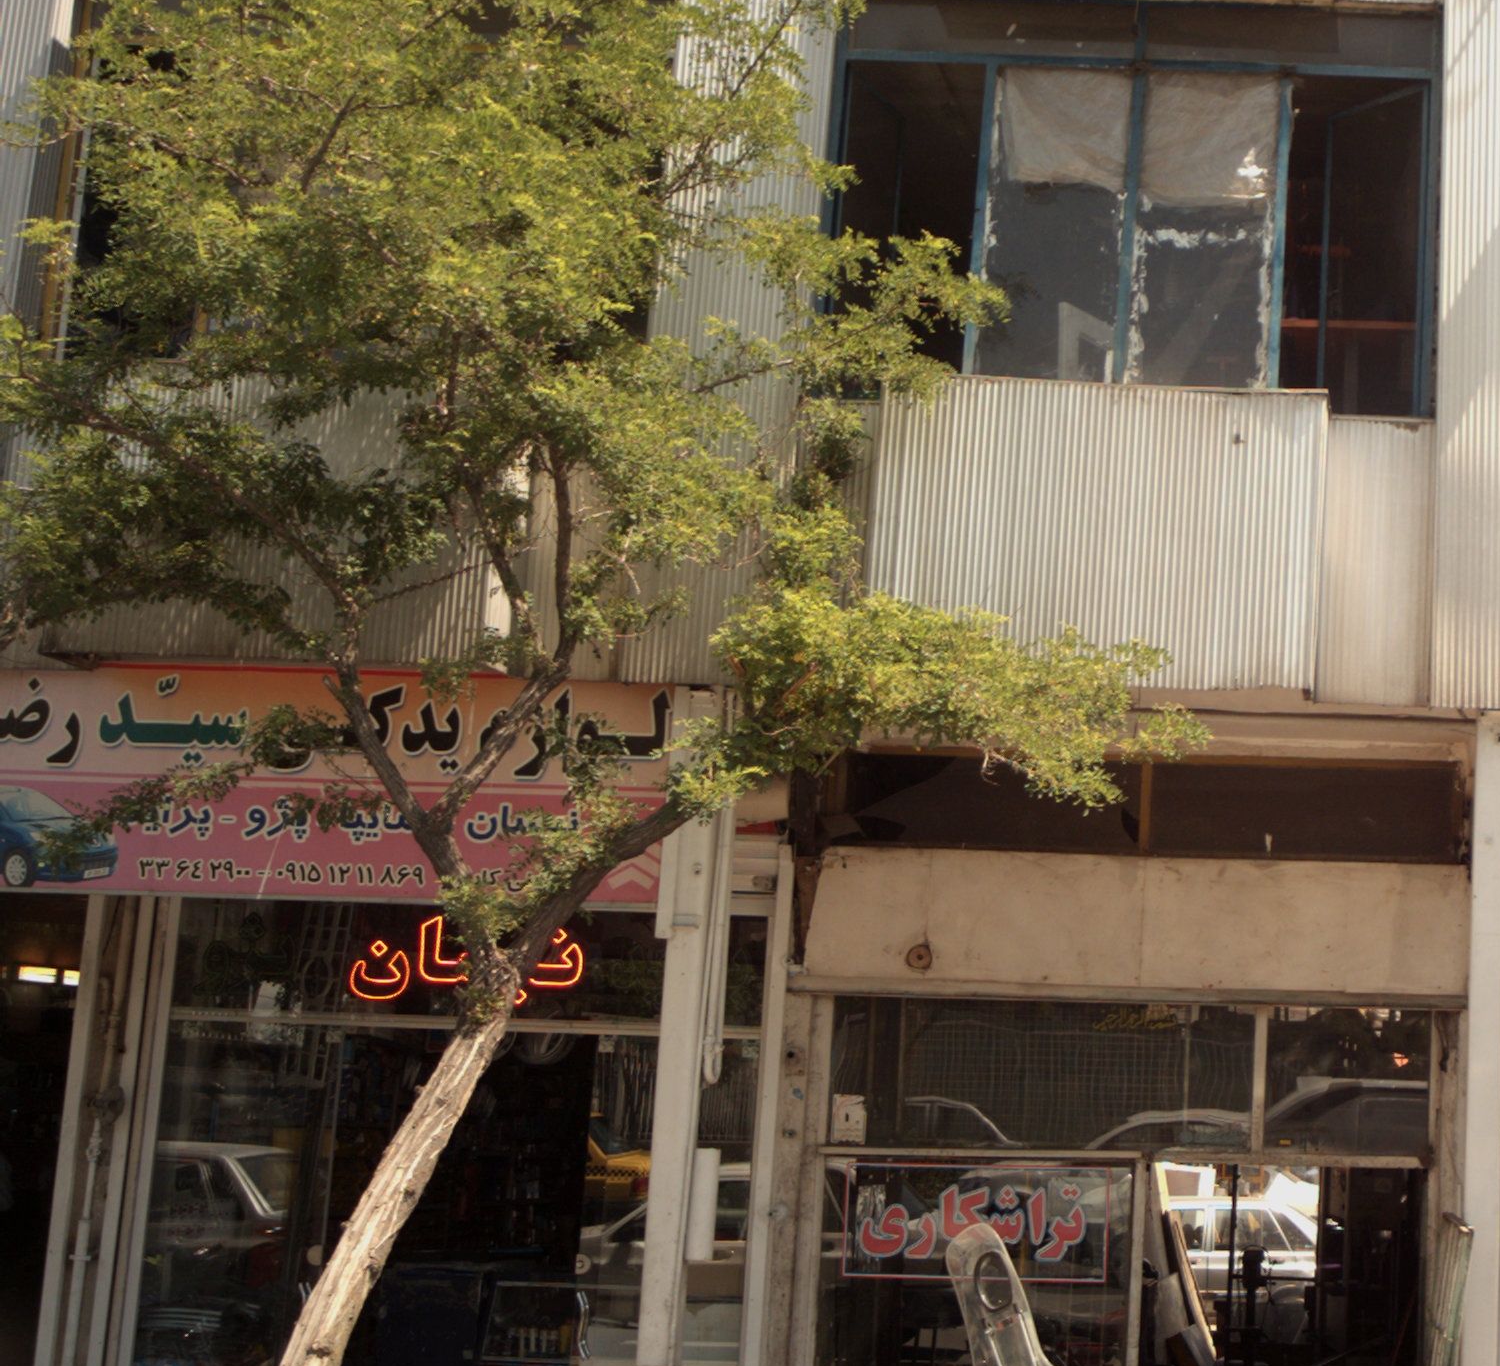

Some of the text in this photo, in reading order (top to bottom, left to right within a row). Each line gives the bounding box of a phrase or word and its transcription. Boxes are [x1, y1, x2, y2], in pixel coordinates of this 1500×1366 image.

[0, 677, 81, 767] رض
[127, 794, 212, 838] پرای
[350, 915, 584, 1004] نان
[857, 1184, 1087, 1262] تراشکاری
